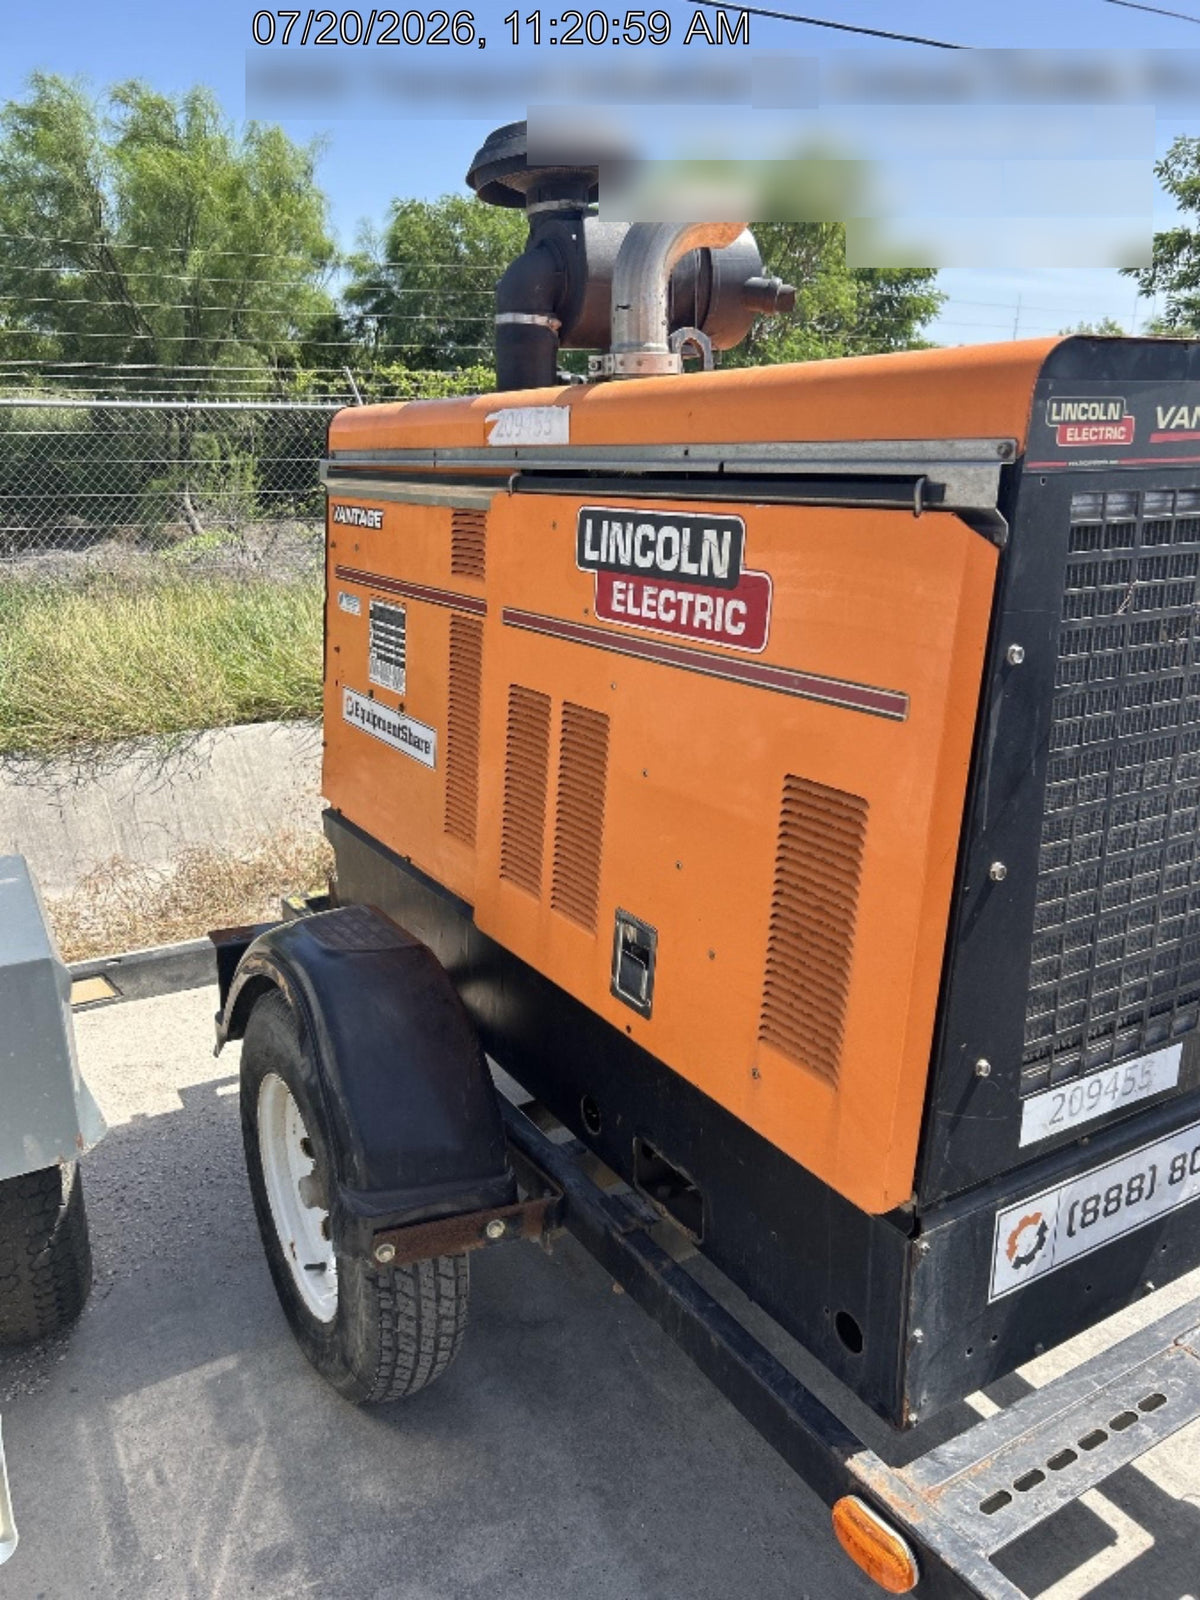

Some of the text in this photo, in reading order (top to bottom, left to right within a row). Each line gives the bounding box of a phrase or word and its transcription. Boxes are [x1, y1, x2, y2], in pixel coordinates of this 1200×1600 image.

[1051, 403, 1120, 421] LINCOLN
[1066, 427, 1126, 441] ELECTRIC
[333, 506, 383, 529] VANTAGE
[584, 519, 731, 578] LINCOLN
[611, 581, 747, 636] ELECTRIC
[354, 699, 432, 755] EquipmentShare
[1066, 1164, 1157, 1238] (888)
